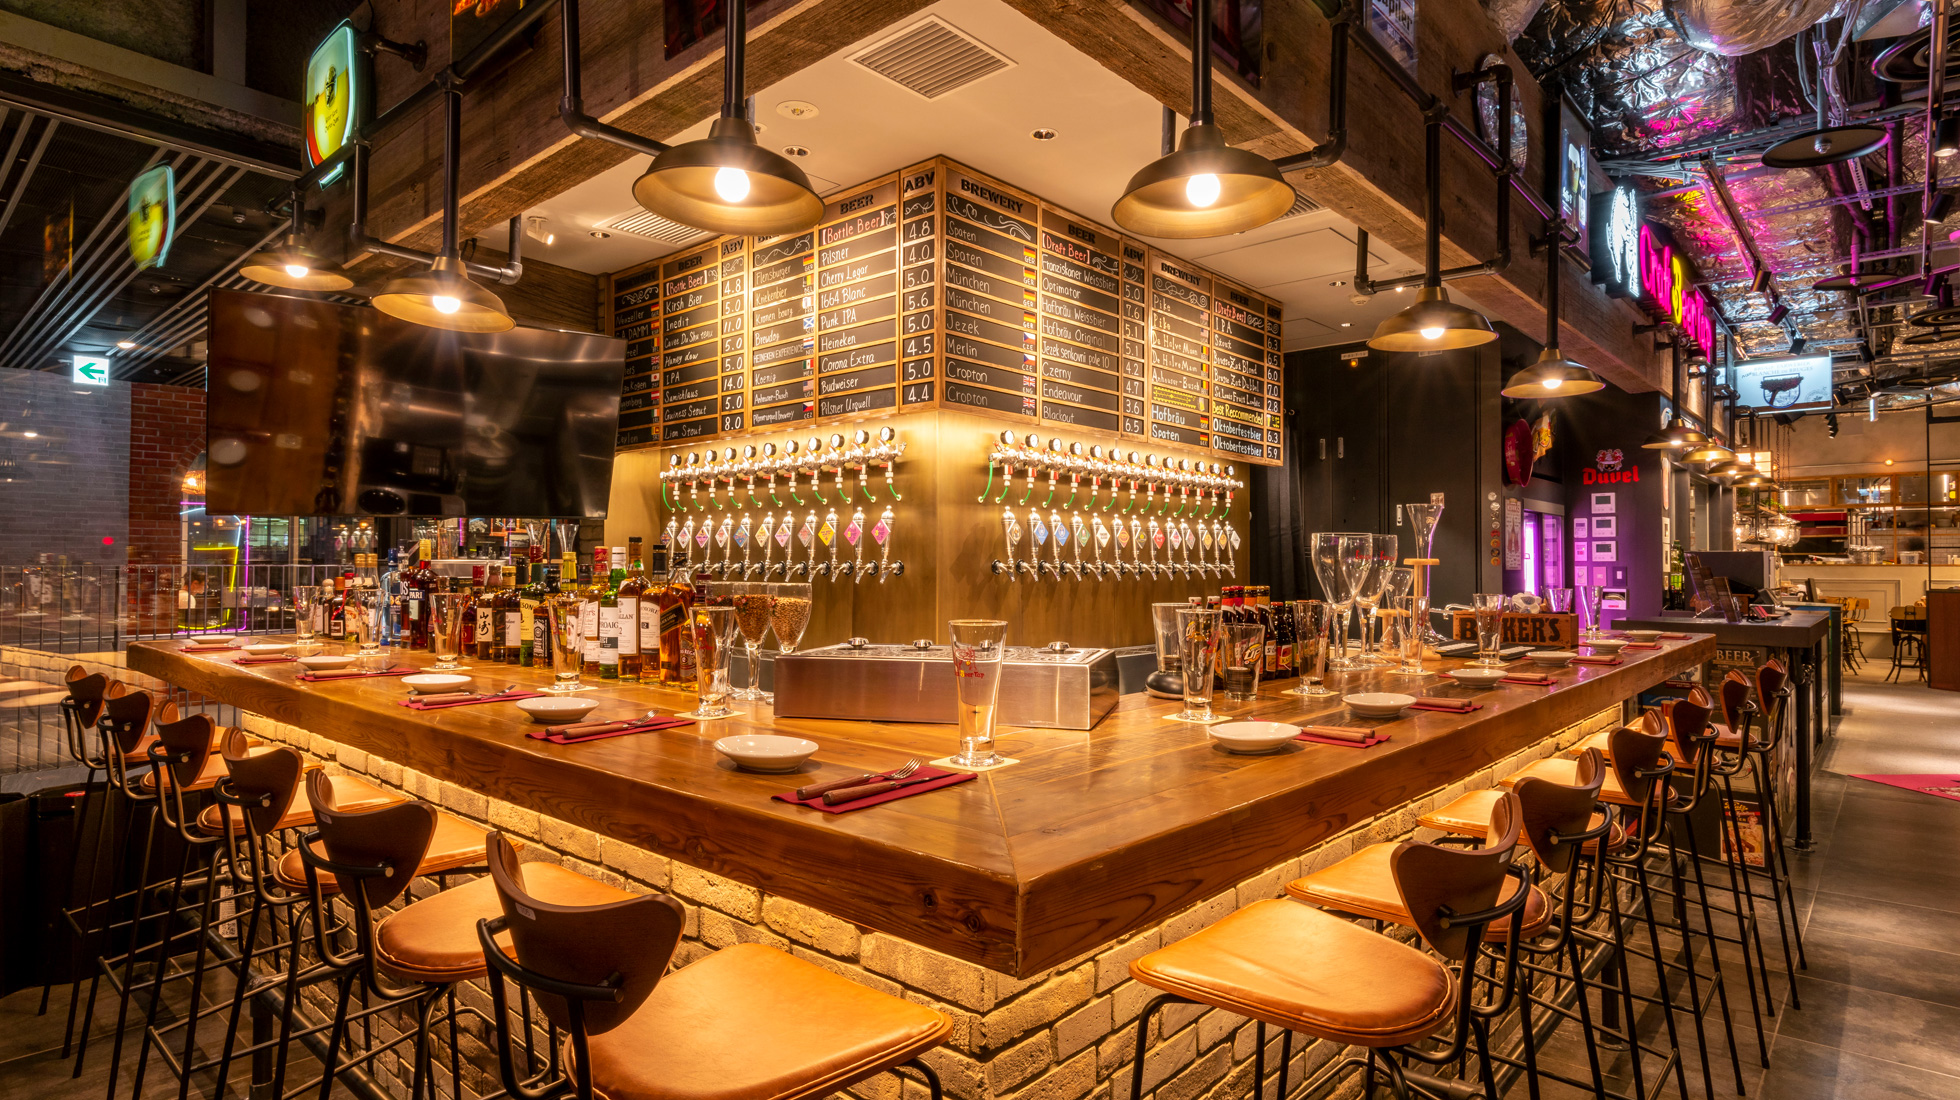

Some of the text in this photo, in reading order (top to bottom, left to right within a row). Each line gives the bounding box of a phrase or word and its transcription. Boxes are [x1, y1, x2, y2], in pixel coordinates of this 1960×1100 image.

[904, 172, 935, 193] ABV
[840, 194, 873, 214] BEER
[961, 179, 1024, 214] BREWERY
[909, 221, 930, 240] 4.8
[949, 221, 976, 242] Spaten
[1068, 224, 1096, 244] BEER
[722, 240, 743, 255] ABV
[909, 245, 930, 263] 4.0
[948, 243, 982, 267] Spaten
[1124, 247, 1144, 262] ABV
[679, 256, 702, 271] BEER
[822, 248, 849, 266] Pilsner
[821, 273, 844, 287] Cherry
[908, 269, 929, 288] 5.0
[947, 268, 990, 294] München
[1042, 253, 1116, 291] Franziskaner Weissbier
[1161, 262, 1200, 286] BREWERY
[725, 279, 741, 294] 4.8
[1042, 277, 1081, 298] Optimator
[1125, 285, 1140, 300] 5.0
[688, 294, 702, 307] Bier
[725, 299, 740, 314] 5.0
[821, 287, 866, 308] 1664 Blanc
[908, 292, 928, 310] 5.6
[947, 291, 991, 315] München
[821, 308, 857, 330] Punk IPA
[1074, 308, 1106, 328] Weissbier
[1126, 304, 1140, 320] 7.6
[724, 318, 741, 332] 11.0
[908, 314, 930, 332] 5.0
[947, 314, 980, 335] Jezek
[1126, 323, 1138, 338] 5.1
[1216, 317, 1232, 334] IPA
[725, 338, 742, 351] 5.0
[821, 333, 856, 351] Heineken
[907, 337, 931, 356] 4.5
[947, 338, 978, 357] Merlin
[1126, 342, 1138, 357] 5.1
[1268, 338, 1278, 350] 6.3
[725, 357, 742, 371] 5.0
[821, 352, 875, 372] Corona Extra
[1102, 356, 1109, 368] 10
[1268, 354, 1278, 365] 6.5
[908, 361, 930, 380] 5.0
[947, 362, 987, 383] Cropton
[1042, 362, 1071, 381] Czerny
[1126, 363, 1139, 376] 4.2
[1268, 369, 1278, 381] 6.0
[724, 376, 743, 391] 14.0
[821, 378, 858, 394] Budweiser
[1043, 383, 1082, 402] Endeavour
[1126, 382, 1139, 395] 4.7
[1268, 384, 1278, 396] 7.0
[725, 395, 742, 409] 5.0
[908, 384, 929, 402] 4.4
[947, 386, 987, 406] Cropton
[821, 401, 843, 416] Pilsner
[1043, 406, 1074, 423] Blackout
[1126, 400, 1140, 414] 3.6
[1152, 404, 1185, 425] Hofbräu
[1268, 400, 1278, 412] 2.8
[725, 416, 741, 430] 8.0
[1126, 418, 1140, 433] 6.5
[1213, 418, 1261, 440] Oktoberfestbier
[1152, 424, 1179, 442] Spaten
[1268, 431, 1278, 443] 6.3
[1213, 435, 1261, 456] Oktoberfestbier
[1268, 447, 1277, 459] 5.9
[1582, 465, 1640, 484] Duvel
